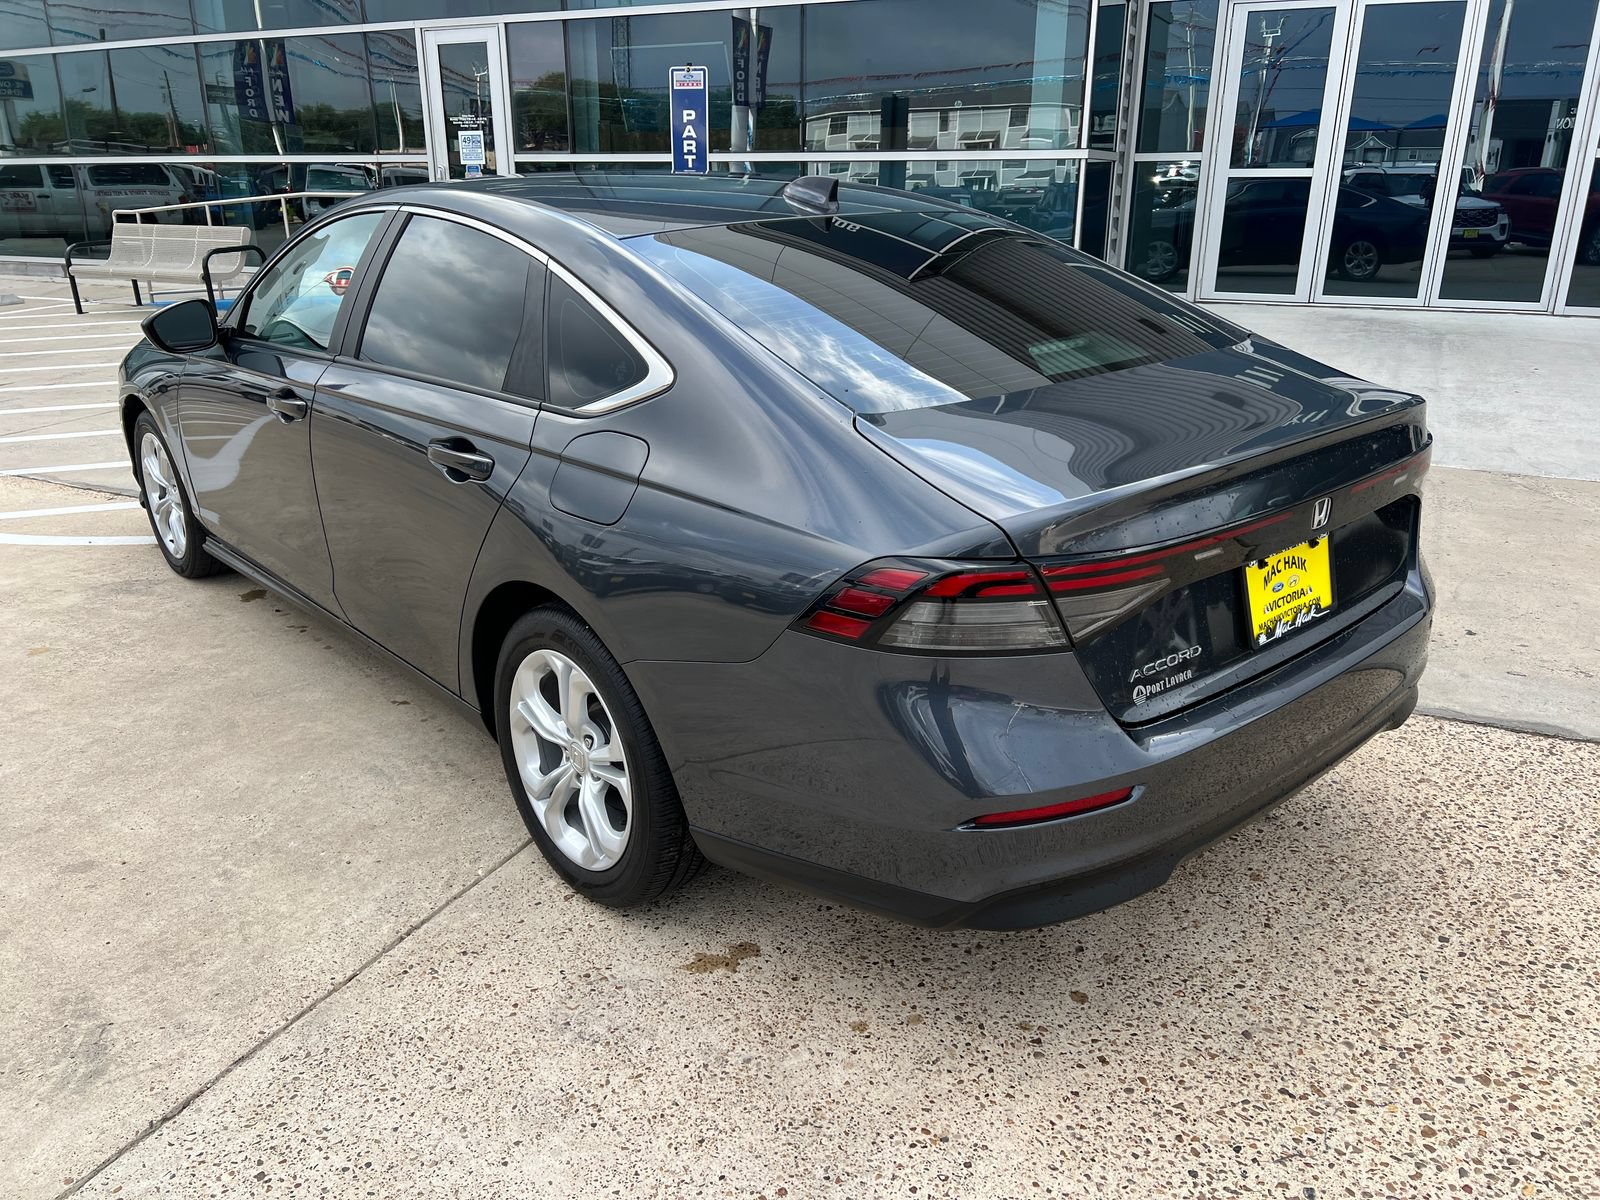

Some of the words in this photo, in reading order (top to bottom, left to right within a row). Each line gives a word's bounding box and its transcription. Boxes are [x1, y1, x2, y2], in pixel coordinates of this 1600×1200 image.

[682, 109, 697, 168] PART
[1263, 559, 1282, 591] MAC
[1283, 555, 1308, 573] HAIK
[1268, 587, 1306, 612] VICTORIA
[1273, 619, 1295, 639] Mac
[1295, 605, 1330, 628] Haik
[1128, 645, 1202, 683] ACCORD
[1145, 679, 1165, 697] PORT
